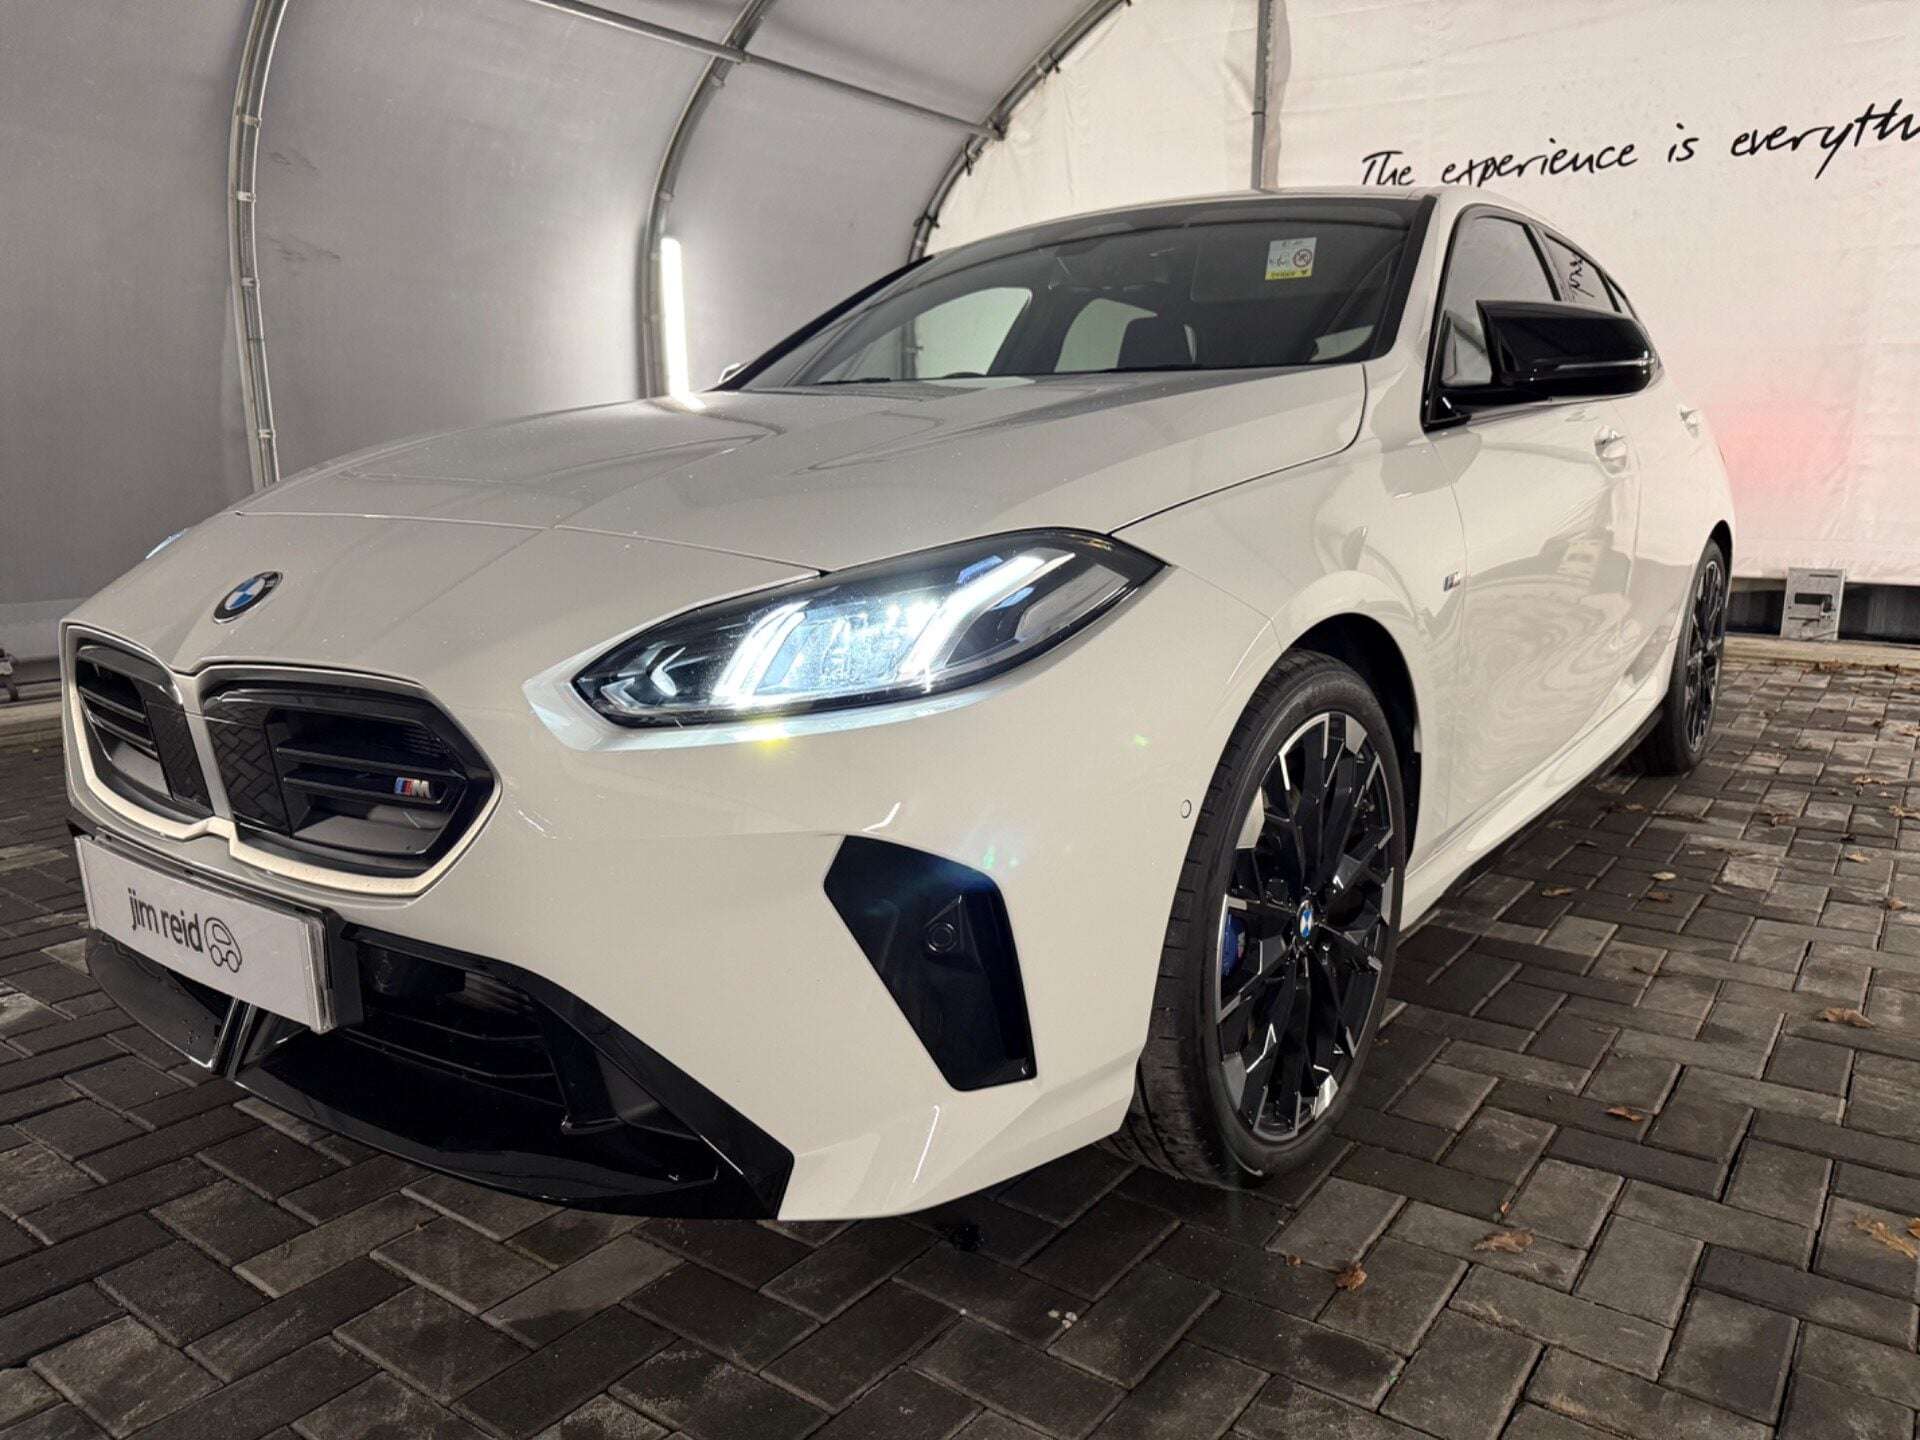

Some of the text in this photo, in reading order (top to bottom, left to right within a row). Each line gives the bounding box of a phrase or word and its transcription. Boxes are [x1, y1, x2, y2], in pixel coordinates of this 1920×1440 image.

[1361, 150, 1415, 185] The
[1441, 137, 1638, 188] experience
[1667, 122, 1700, 163] is
[128, 887, 204, 953] jim reid
